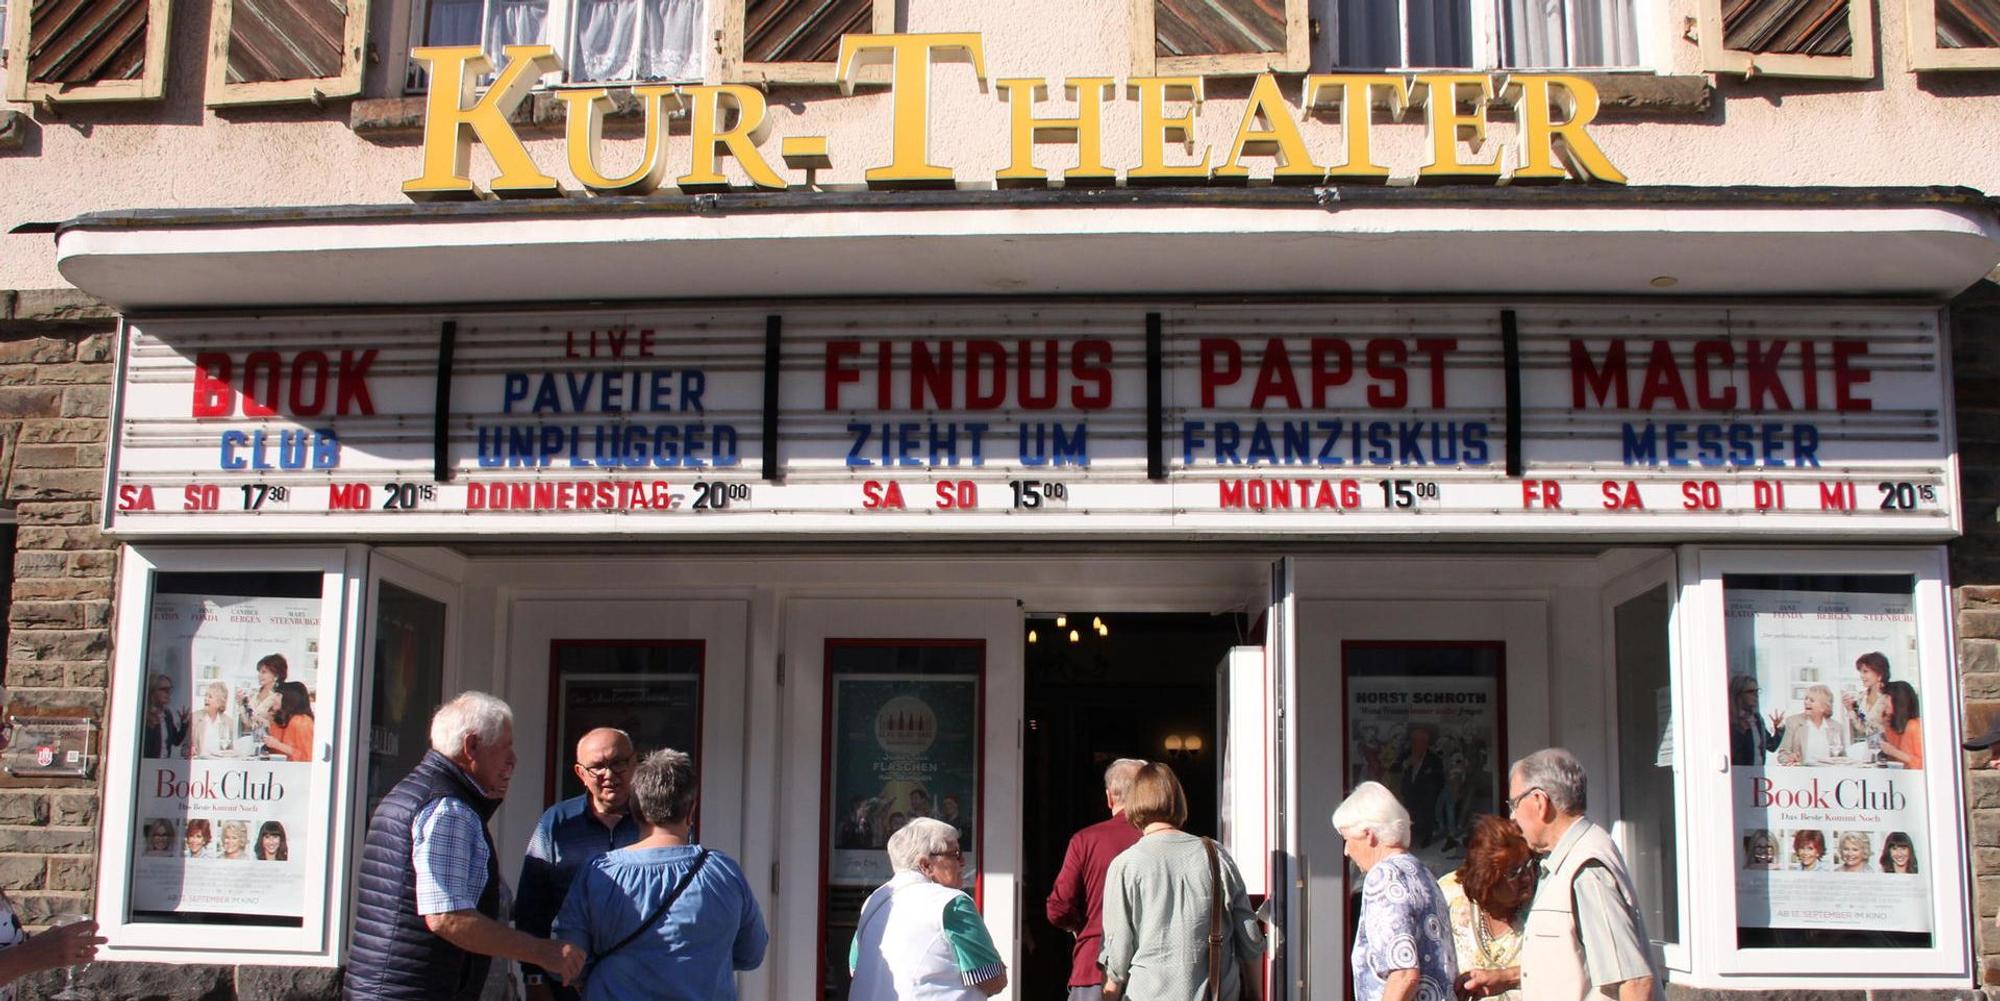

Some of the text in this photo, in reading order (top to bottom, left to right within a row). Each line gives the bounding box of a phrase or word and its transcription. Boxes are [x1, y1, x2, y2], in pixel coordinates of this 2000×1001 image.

[565, 329, 657, 359] LIVE
[191, 348, 382, 417] BOOK
[503, 370, 706, 414] PAVEIER
[824, 339, 1114, 411] FINDUS
[1200, 337, 1458, 410] PAPST
[1570, 339, 1873, 411] MACKIE
[220, 429, 342, 470] CLUB
[477, 424, 739, 467] UNPLUGGED
[845, 423, 1088, 466] ZIEHT UM
[1183, 420, 1489, 466] FRANZISKUS
[1622, 422, 1822, 467] MESSER
[117, 484, 155, 510] SA
[183, 484, 220, 510] SO
[328, 483, 371, 510] MO
[466, 481, 671, 510] DONNERSTAG
[863, 479, 905, 510] SA
[936, 480, 975, 509] SO
[1219, 478, 1360, 509] MONTAG
[1521, 480, 1562, 510] FR
[1602, 480, 1645, 510] SA
[1682, 481, 1722, 510] SO
[1754, 480, 1785, 511] DI
[1819, 481, 1858, 512] MI
[1356, 692, 1487, 704] HORST SCHROTH
[156, 768, 285, 800] Book Club
[1752, 776, 1906, 811] Book Club
